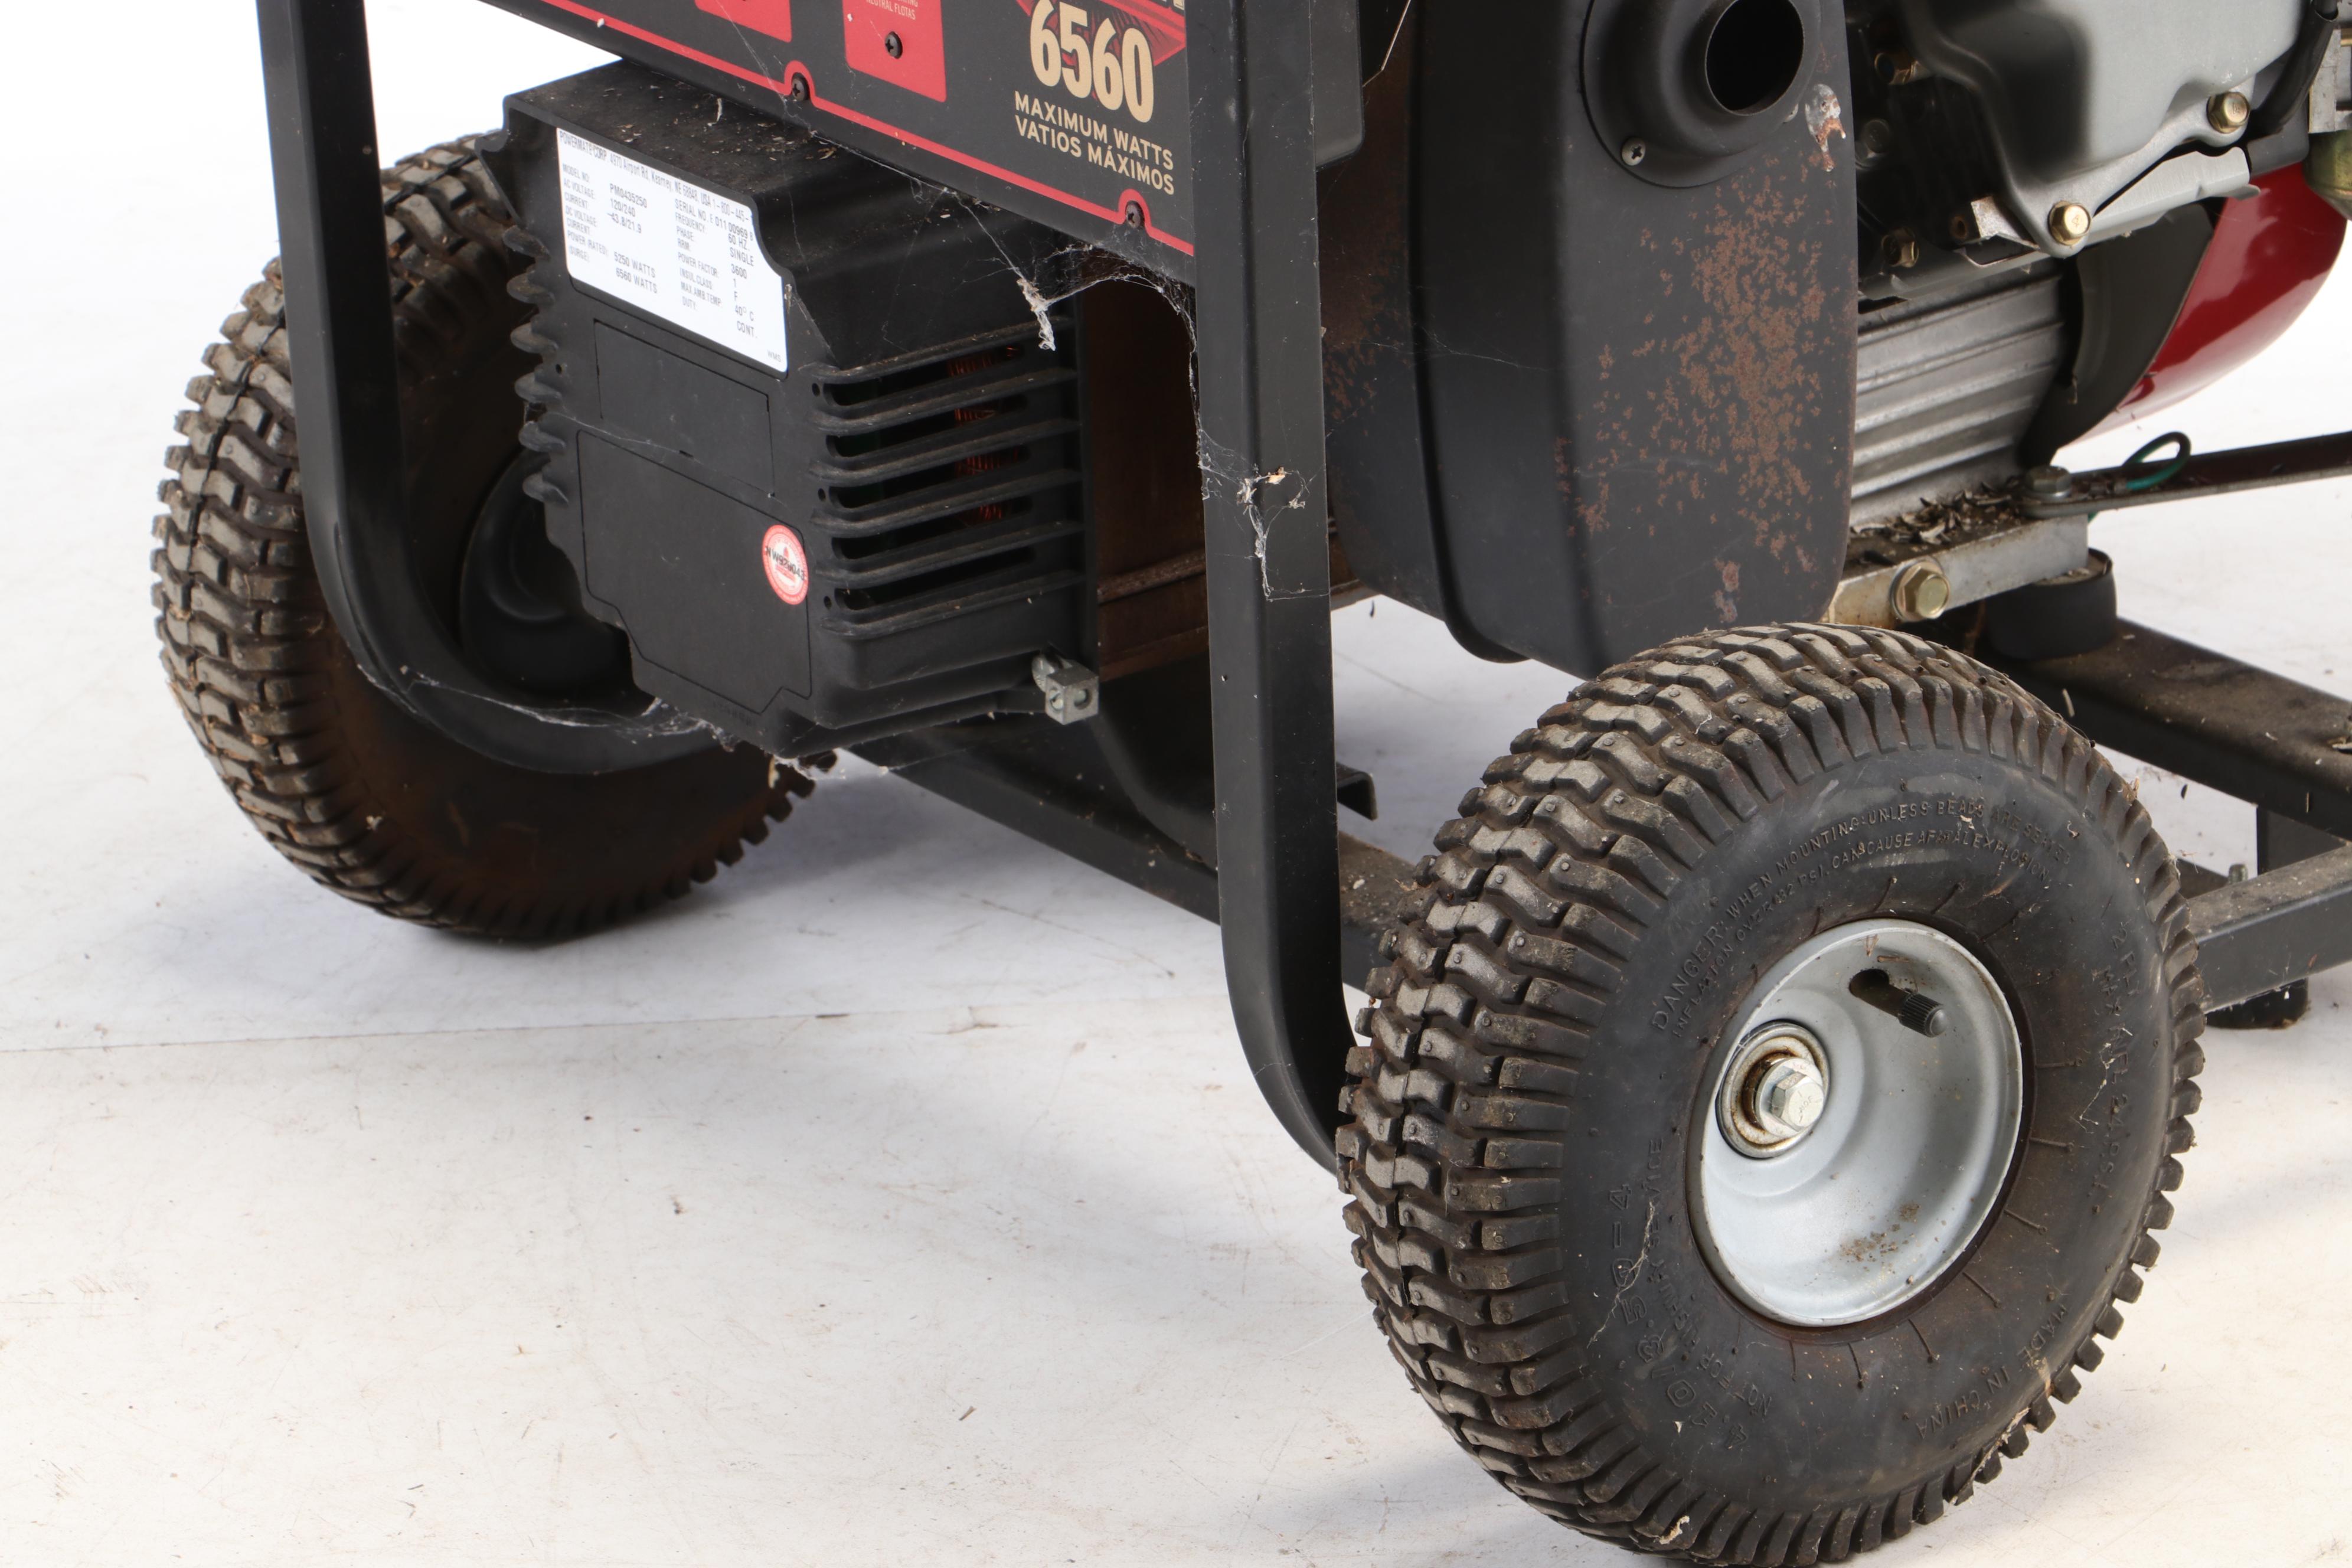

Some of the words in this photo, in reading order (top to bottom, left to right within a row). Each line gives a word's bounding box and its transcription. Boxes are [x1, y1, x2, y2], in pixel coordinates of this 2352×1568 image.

[894, 2, 916, 20] FLOTAS
[1030, 0, 1154, 123] 6560
[1015, 90, 1108, 143] MAXIMUM
[1113, 128, 1174, 170] WATTS
[560, 130, 592, 155] POWERMATE
[1015, 115, 1082, 158] VATIOS
[1087, 142, 1174, 195] MÁXIMOS
[563, 163, 580, 179] MODEL
[563, 178, 571, 189] AC
[610, 198, 636, 218] 120/240
[675, 198, 696, 217] SERIAL
[728, 233, 736, 245] 60
[614, 251, 630, 267] 5250
[632, 259, 656, 279] WATTS
[678, 251, 697, 269] POWER
[730, 247, 754, 267] SINGLE
[616, 267, 632, 283] 6560
[633, 275, 658, 294] WATTS
[731, 263, 747, 279] 3600
[1866, 832, 1913, 855] CAUSE
[1726, 872, 1773, 922] WHEN
[1867, 801, 1929, 825] UNLESS
[1986, 1366, 2011, 1394] IN
[1915, 1390, 1981, 1440] CHINA
